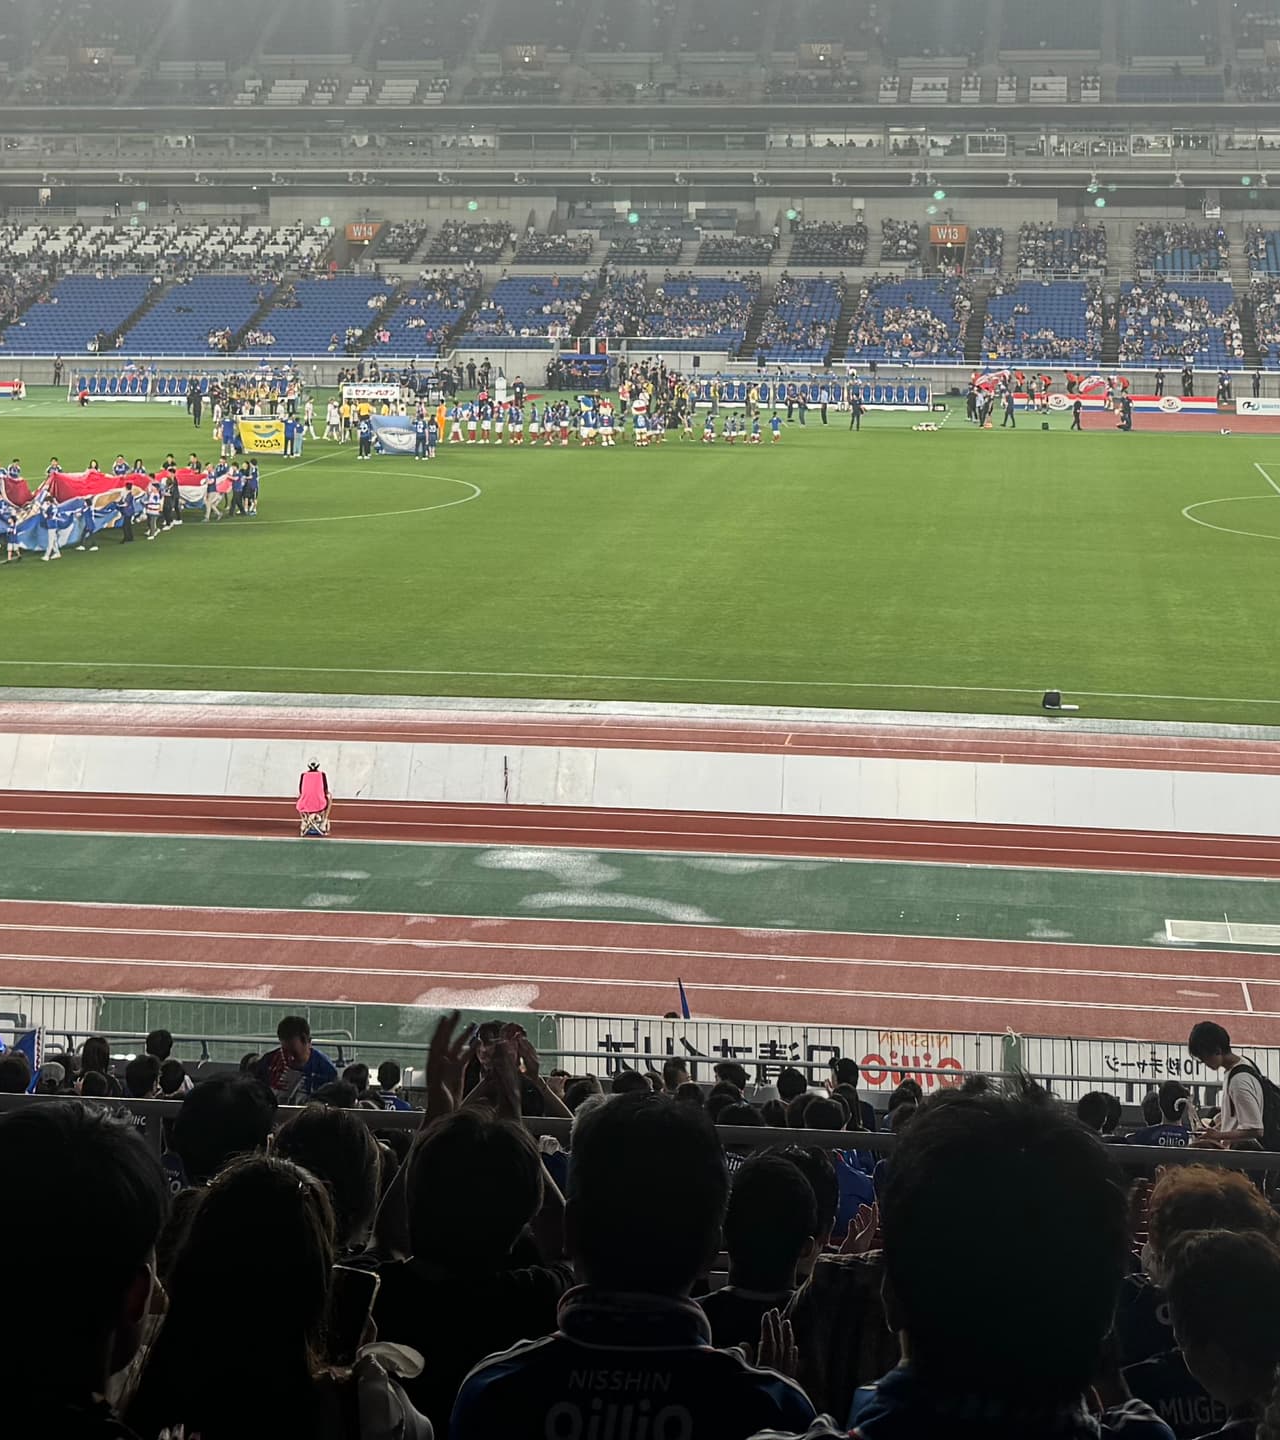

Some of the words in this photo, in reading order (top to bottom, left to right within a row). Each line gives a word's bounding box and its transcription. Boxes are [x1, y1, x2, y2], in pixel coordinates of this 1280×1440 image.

[516, 45, 537, 57] W24
[811, 43, 832, 55] W23
[352, 226, 373, 237] W14
[936, 229, 959, 240] W13
[568, 1368, 673, 1393] NISSHIN
